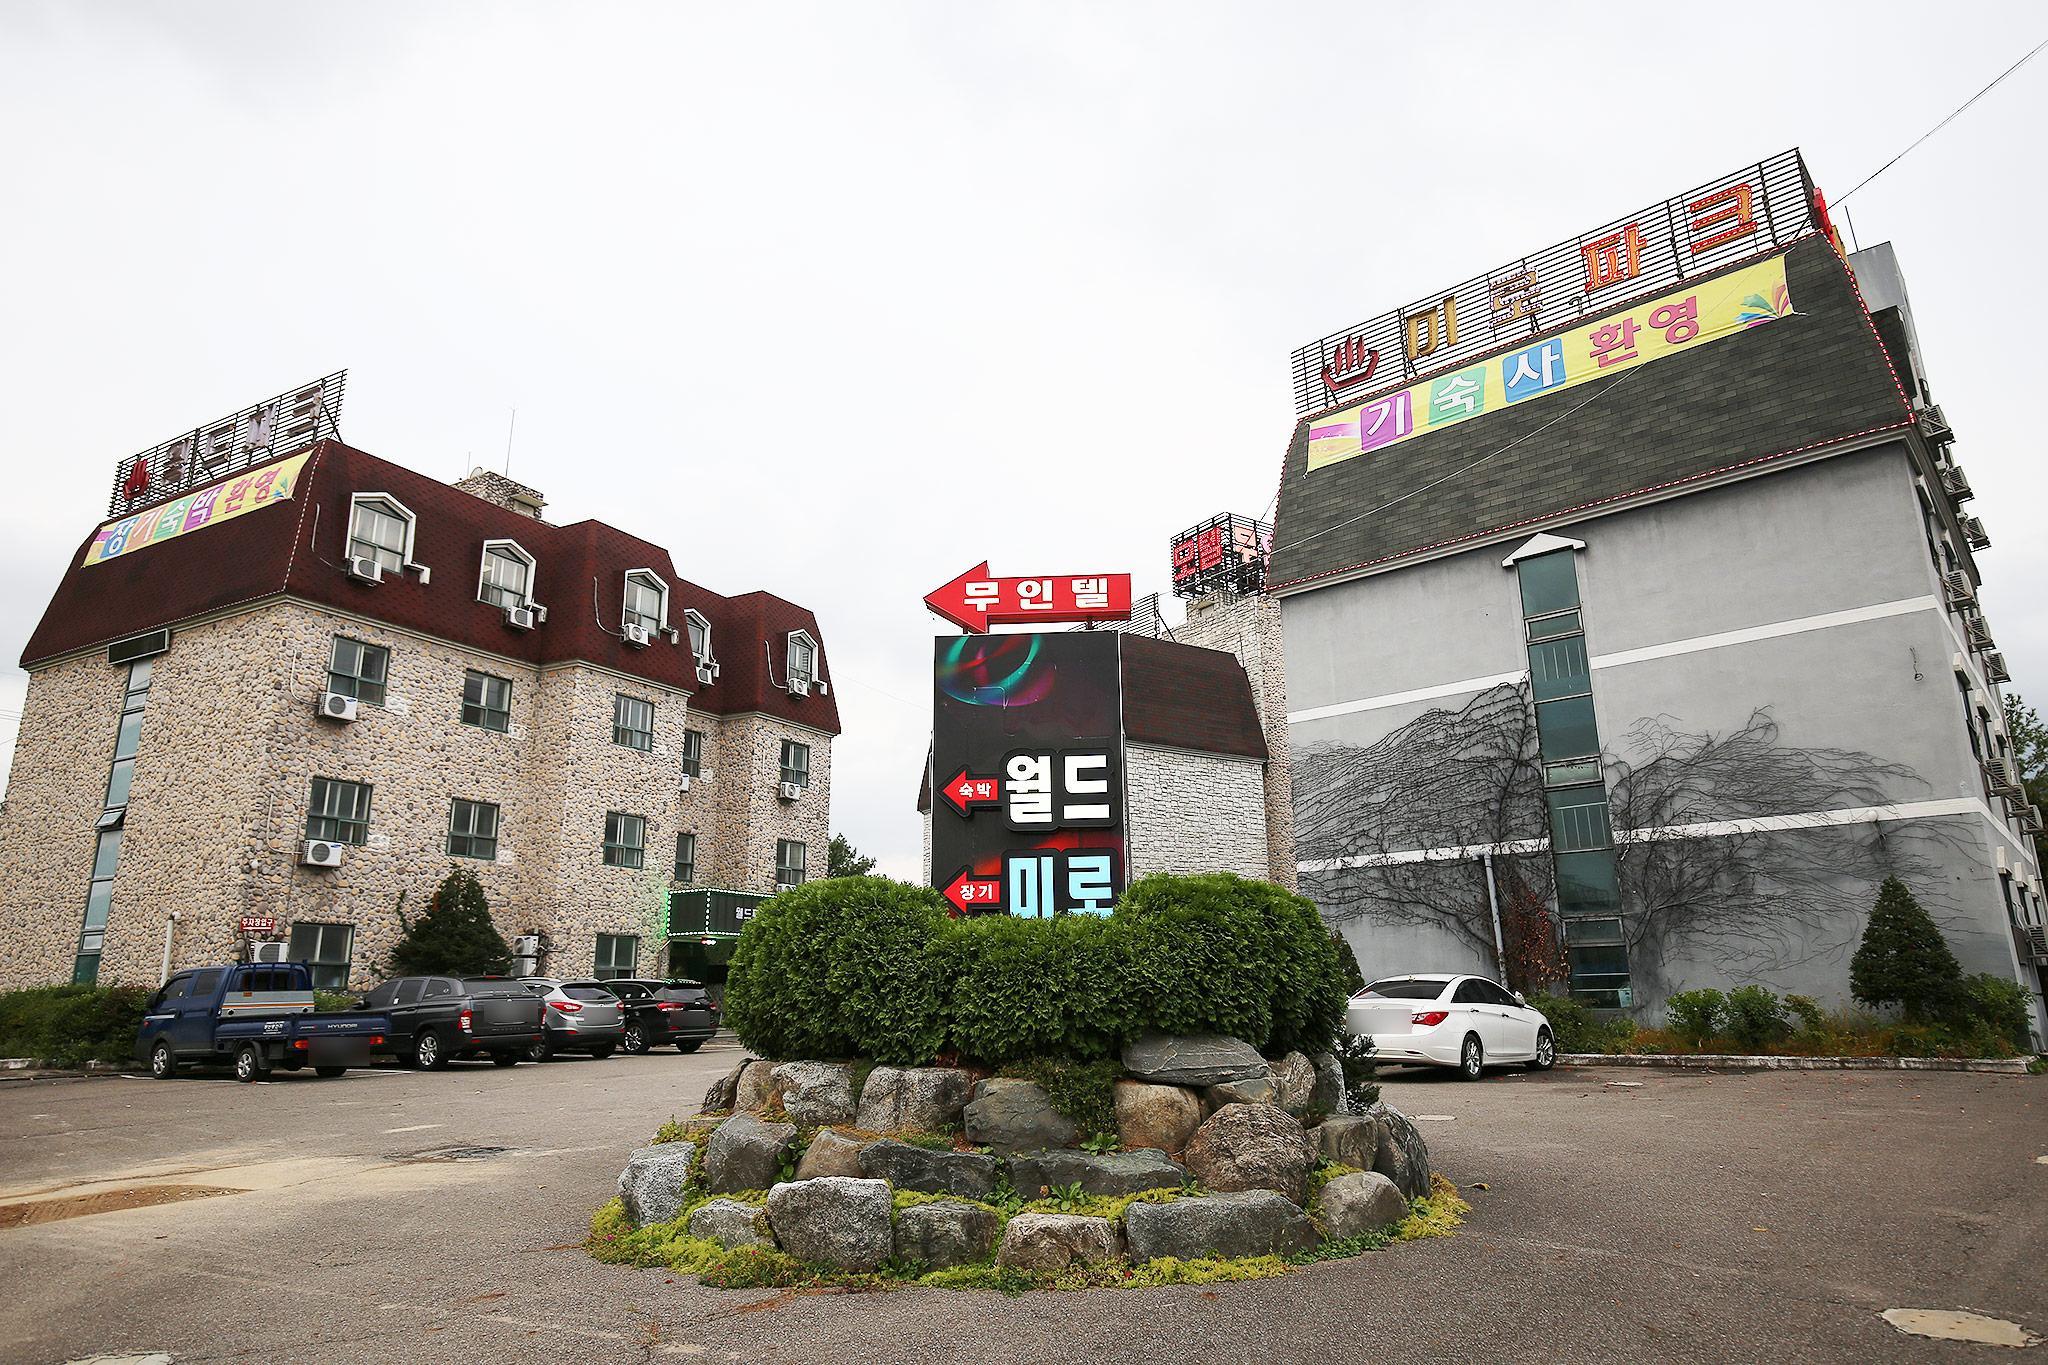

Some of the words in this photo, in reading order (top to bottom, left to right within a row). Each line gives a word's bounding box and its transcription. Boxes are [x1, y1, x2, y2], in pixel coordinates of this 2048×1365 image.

[1407, 183, 1757, 361] 미로파크
[1367, 343, 1561, 437] 기숙사
[1588, 295, 1701, 369] 환영
[224, 467, 282, 513] 환영
[1173, 526, 1223, 582] 모텔
[963, 577, 1110, 612] 무인텔
[958, 782, 992, 798] 숙박
[1005, 754, 1110, 824] 월드
[959, 883, 994, 901] 장기
[1008, 855, 1114, 920] 미로
